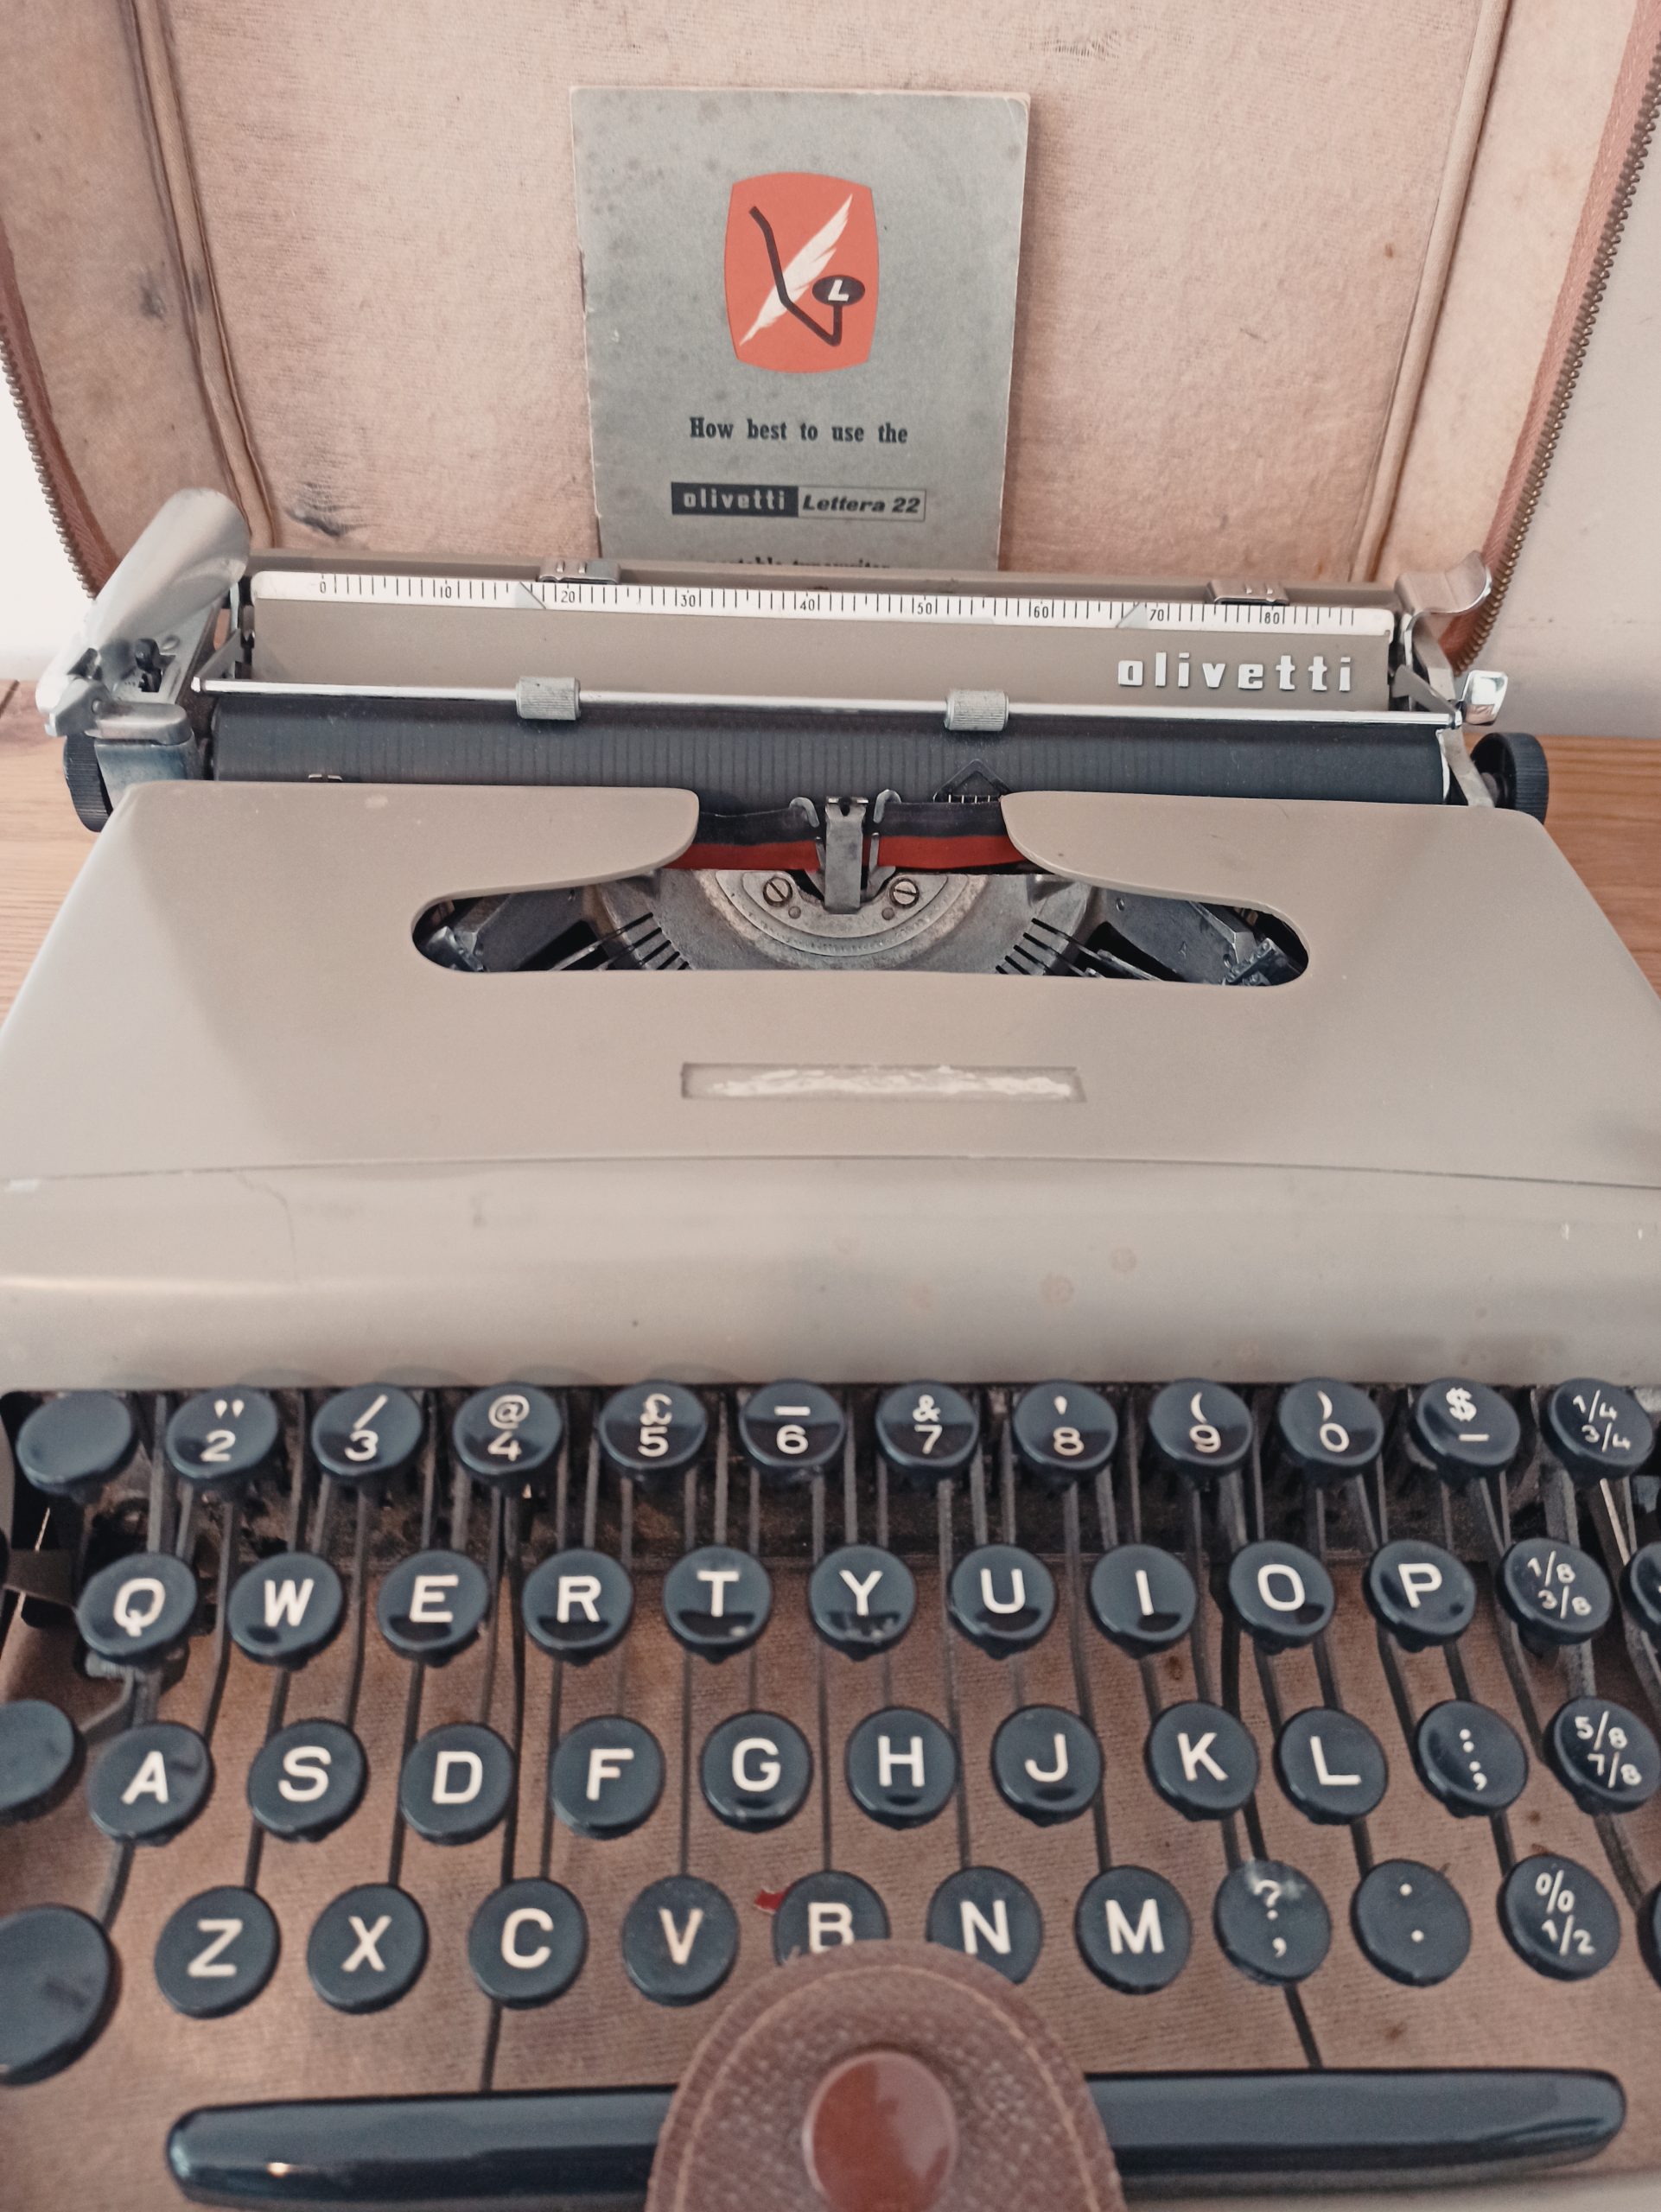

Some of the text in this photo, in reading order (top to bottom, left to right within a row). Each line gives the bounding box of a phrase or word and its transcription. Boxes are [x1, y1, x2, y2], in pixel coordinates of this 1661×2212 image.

[827, 278, 850, 302] L
[689, 417, 908, 443] How best to use the
[683, 487, 921, 514] olivetti Lettera 22
[319, 581, 1281, 626] 0 10 20 30 40 50 60 70 80
[1117, 652, 1351, 691] olivetti
[353, 1395, 388, 1432] /
[488, 1395, 530, 1429] @
[640, 1393, 672, 1426] £
[912, 1395, 940, 1422] &
[1190, 1393, 1206, 1423] (
[1318, 1392, 1333, 1420] )
[1446, 1388, 1477, 1421] $
[201, 1429, 236, 1462] 2
[345, 1429, 379, 1461] 3
[487, 1430, 521, 1461] 4
[638, 1426, 669, 1457] 5
[776, 1424, 809, 1454] 6
[914, 1424, 943, 1454] 7
[1053, 1427, 1085, 1456] 8
[1189, 1424, 1221, 1452] 9
[113, 1578, 166, 1637] Q
[264, 1578, 315, 1627] W
[410, 1574, 459, 1623] E
[557, 1575, 601, 1623] R
[697, 1569, 740, 1617] T
[839, 1569, 882, 1616] Y
[980, 1568, 1026, 1614] U
[1136, 1569, 1154, 1616] I
[1257, 1563, 1305, 1611] O
[1397, 1562, 1442, 1608] P
[878, 1735, 925, 1787] H
[1025, 1733, 1068, 1783] J
[1177, 1732, 1228, 1781] K
[1309, 1736, 1362, 1785] L
[1459, 1728, 1474, 1753] :
[122, 1751, 169, 1804] A
[278, 1745, 332, 1802] S
[432, 1751, 483, 1804] D
[586, 1747, 634, 1801] F
[732, 1738, 781, 1792] G
[1469, 1761, 1487, 1790] ;
[1253, 1878, 1282, 1920] ?
[188, 1918, 243, 1977] Z
[342, 1916, 391, 1972] X
[501, 1907, 553, 1968] C
[659, 1909, 703, 1965] V
[808, 1902, 855, 1955] B
[960, 1899, 1011, 1955] N
[1105, 1898, 1165, 1954] M
[1273, 1937, 1287, 1956] ,
